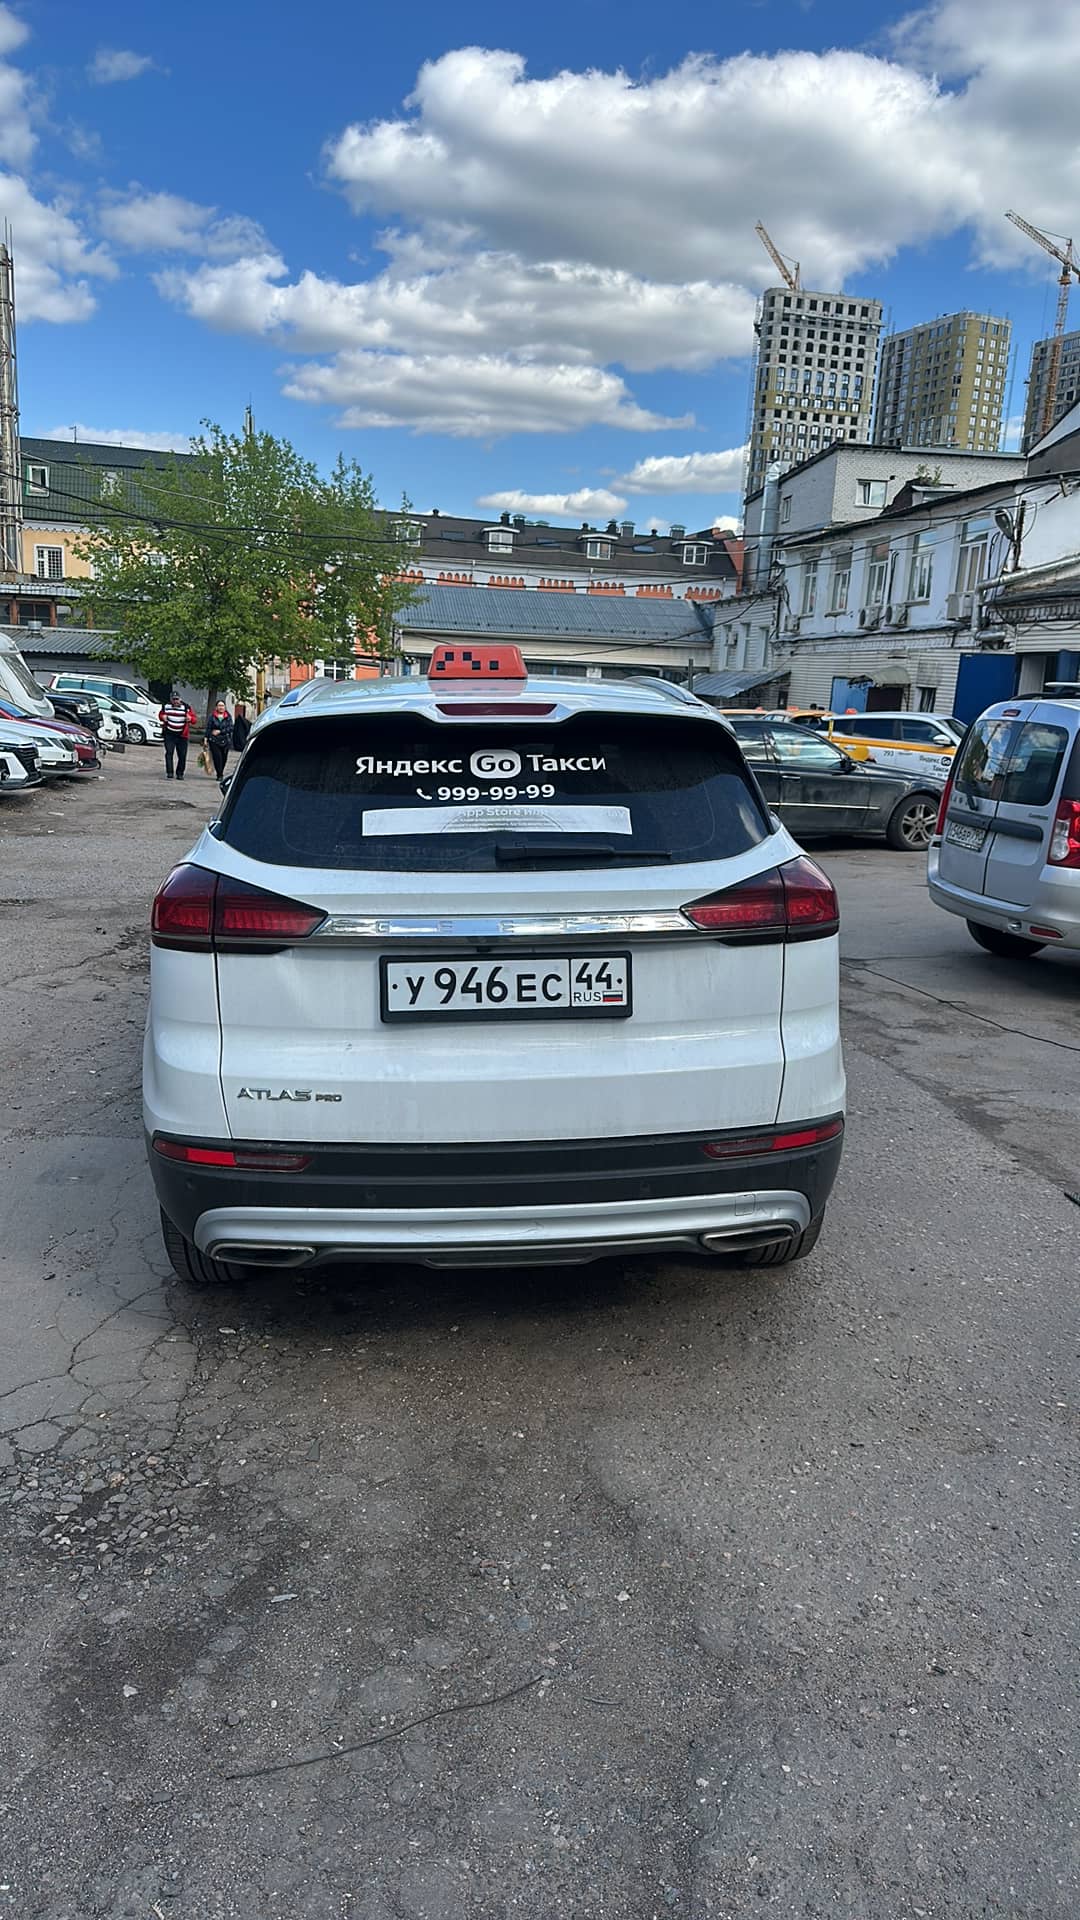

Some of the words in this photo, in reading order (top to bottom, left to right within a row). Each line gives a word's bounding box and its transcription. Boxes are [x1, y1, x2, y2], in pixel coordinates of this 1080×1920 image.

[355, 755, 463, 777] Яндекс
[474, 753, 518, 774] Go
[526, 754, 607, 772] Такси
[437, 784, 555, 801] 999-99-99
[486, 807, 521, 817] Store
[575, 962, 612, 990] 44
[573, 991, 601, 1002] RUS
[237, 1087, 313, 1102] ATLAS
[315, 1093, 342, 1102] PRO
